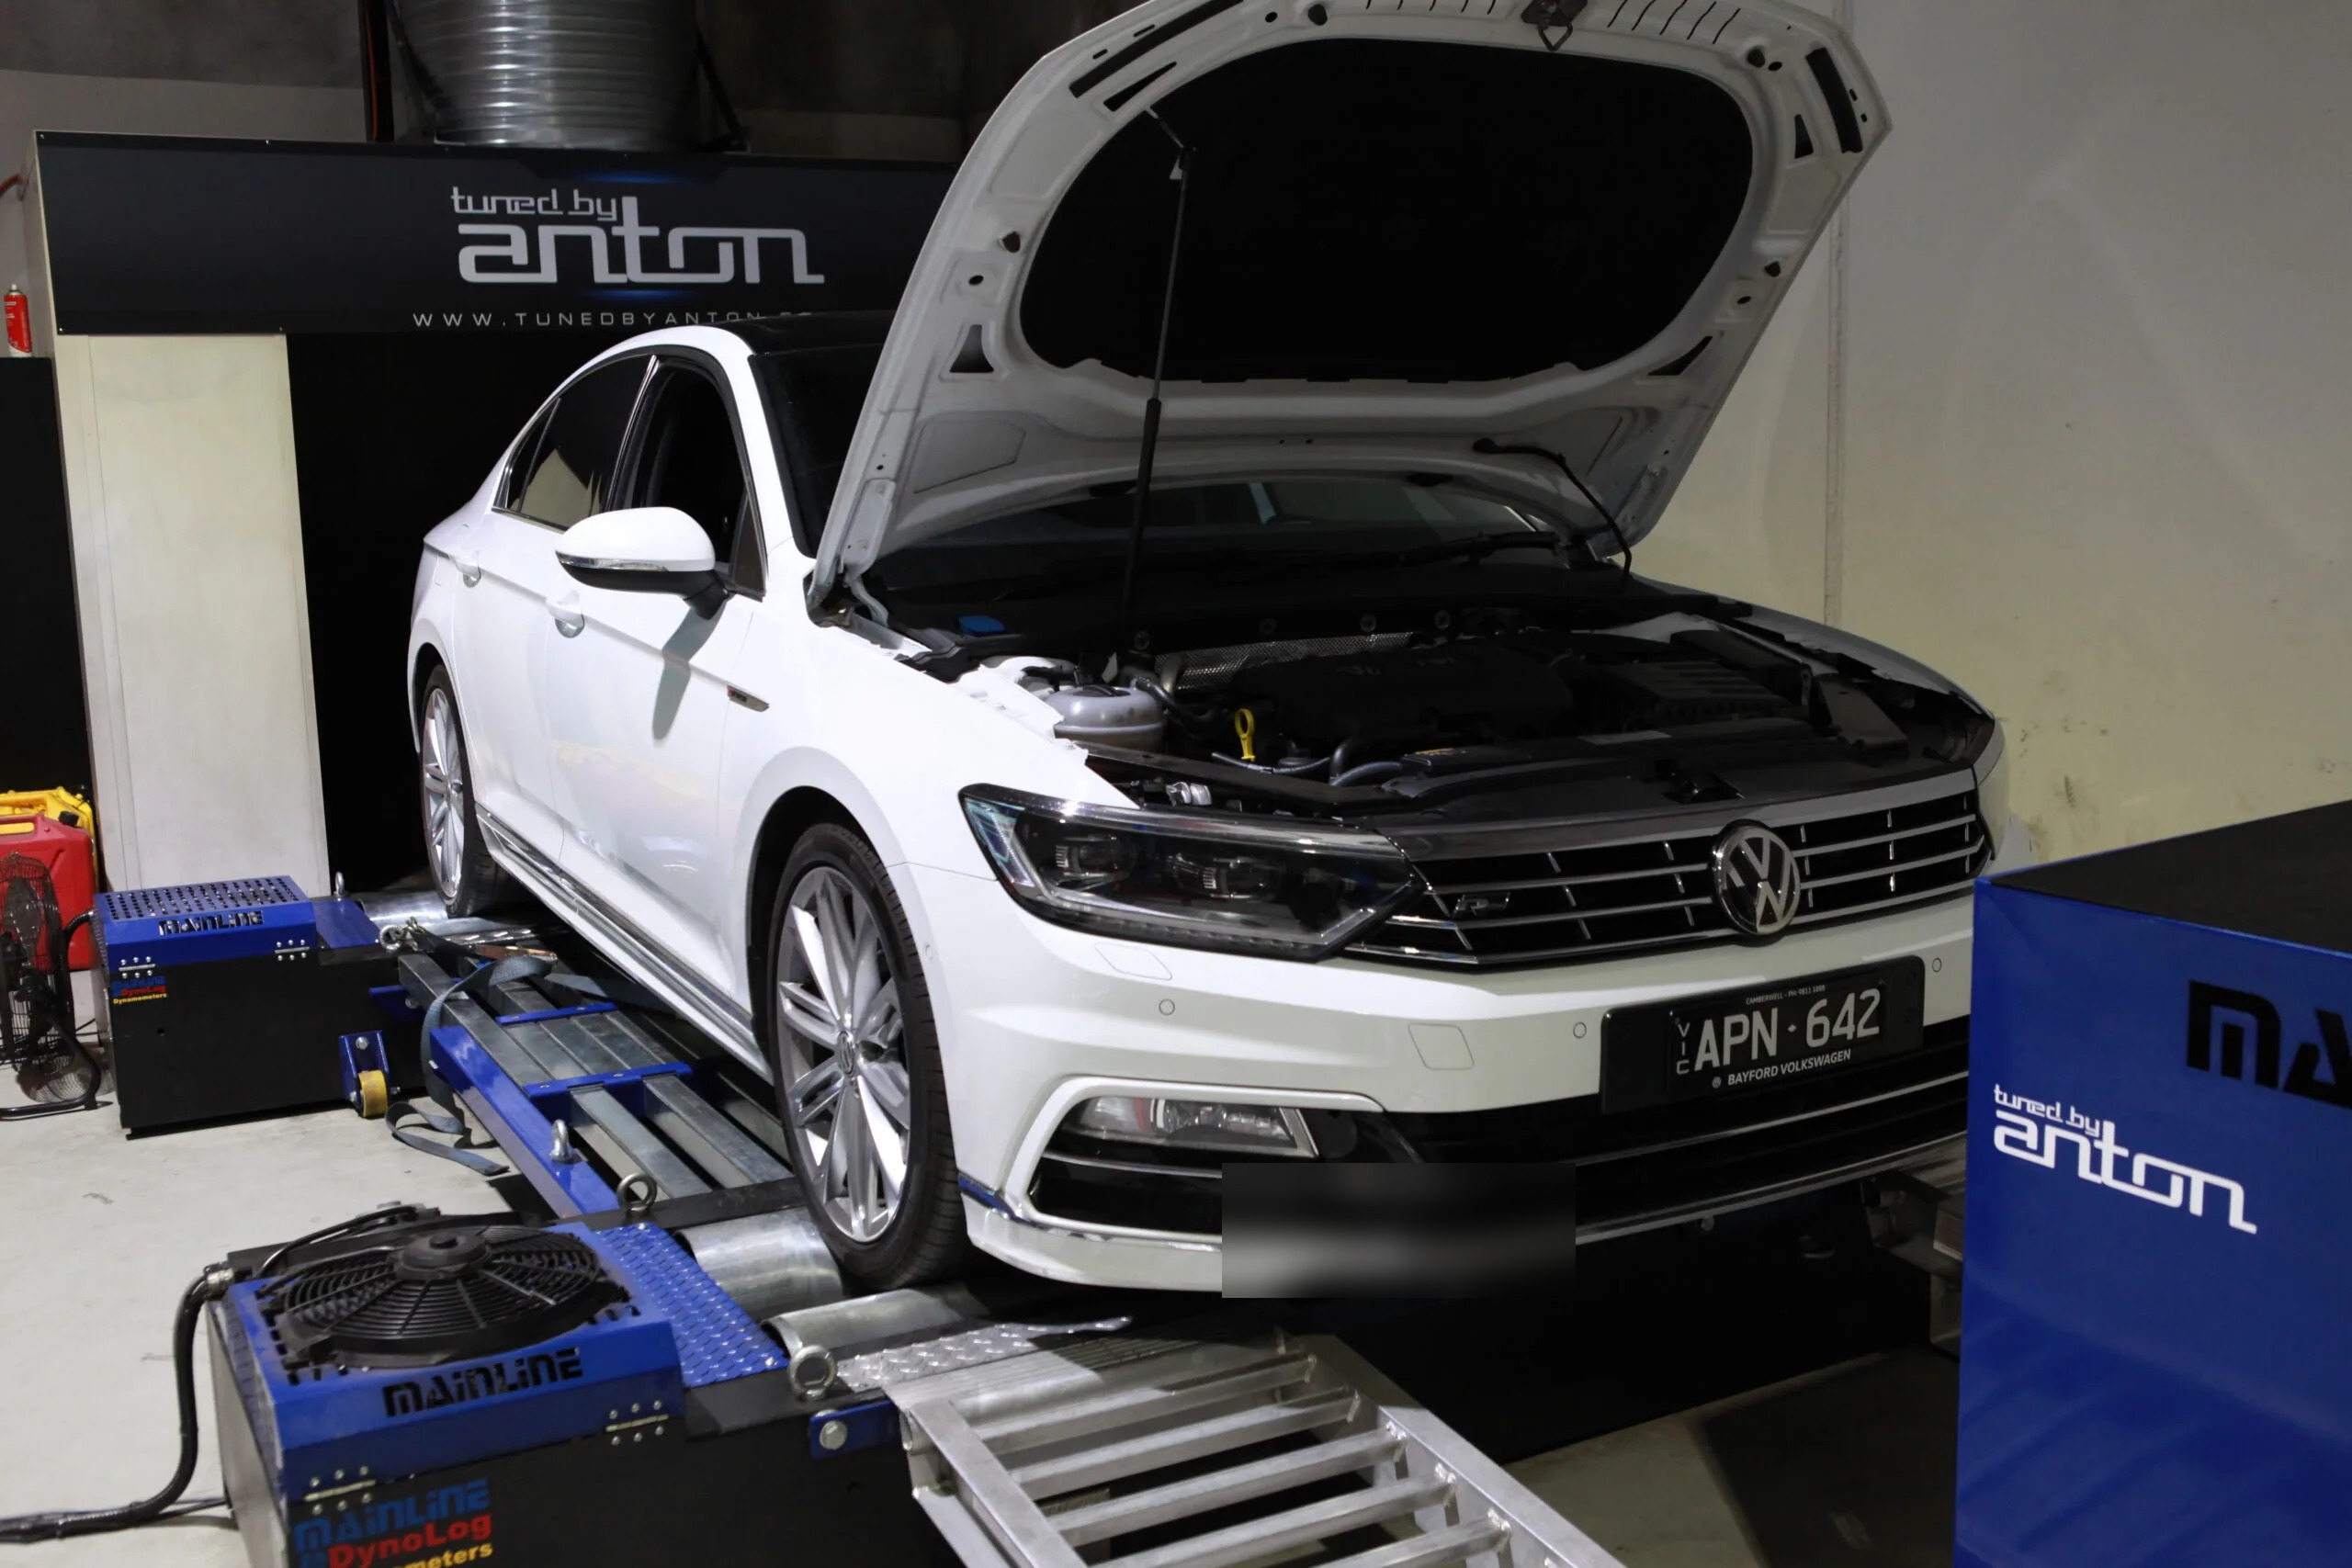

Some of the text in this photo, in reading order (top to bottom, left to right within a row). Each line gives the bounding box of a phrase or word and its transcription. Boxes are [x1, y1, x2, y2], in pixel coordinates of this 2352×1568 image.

[450, 186, 618, 221] tuned by
[458, 196, 825, 284] anton
[1746, 992, 1783, 1005] CAMBERWELL
[1676, 1021, 1690, 1075] VIC
[1693, 988, 1881, 1071] APN 642
[1727, 1066, 1779, 1086] BAYFORD
[1780, 1049, 1851, 1076] VOLKSWAGEN
[1994, 1084, 2100, 1139] tuned by
[1994, 1110, 2257, 1235] anton
